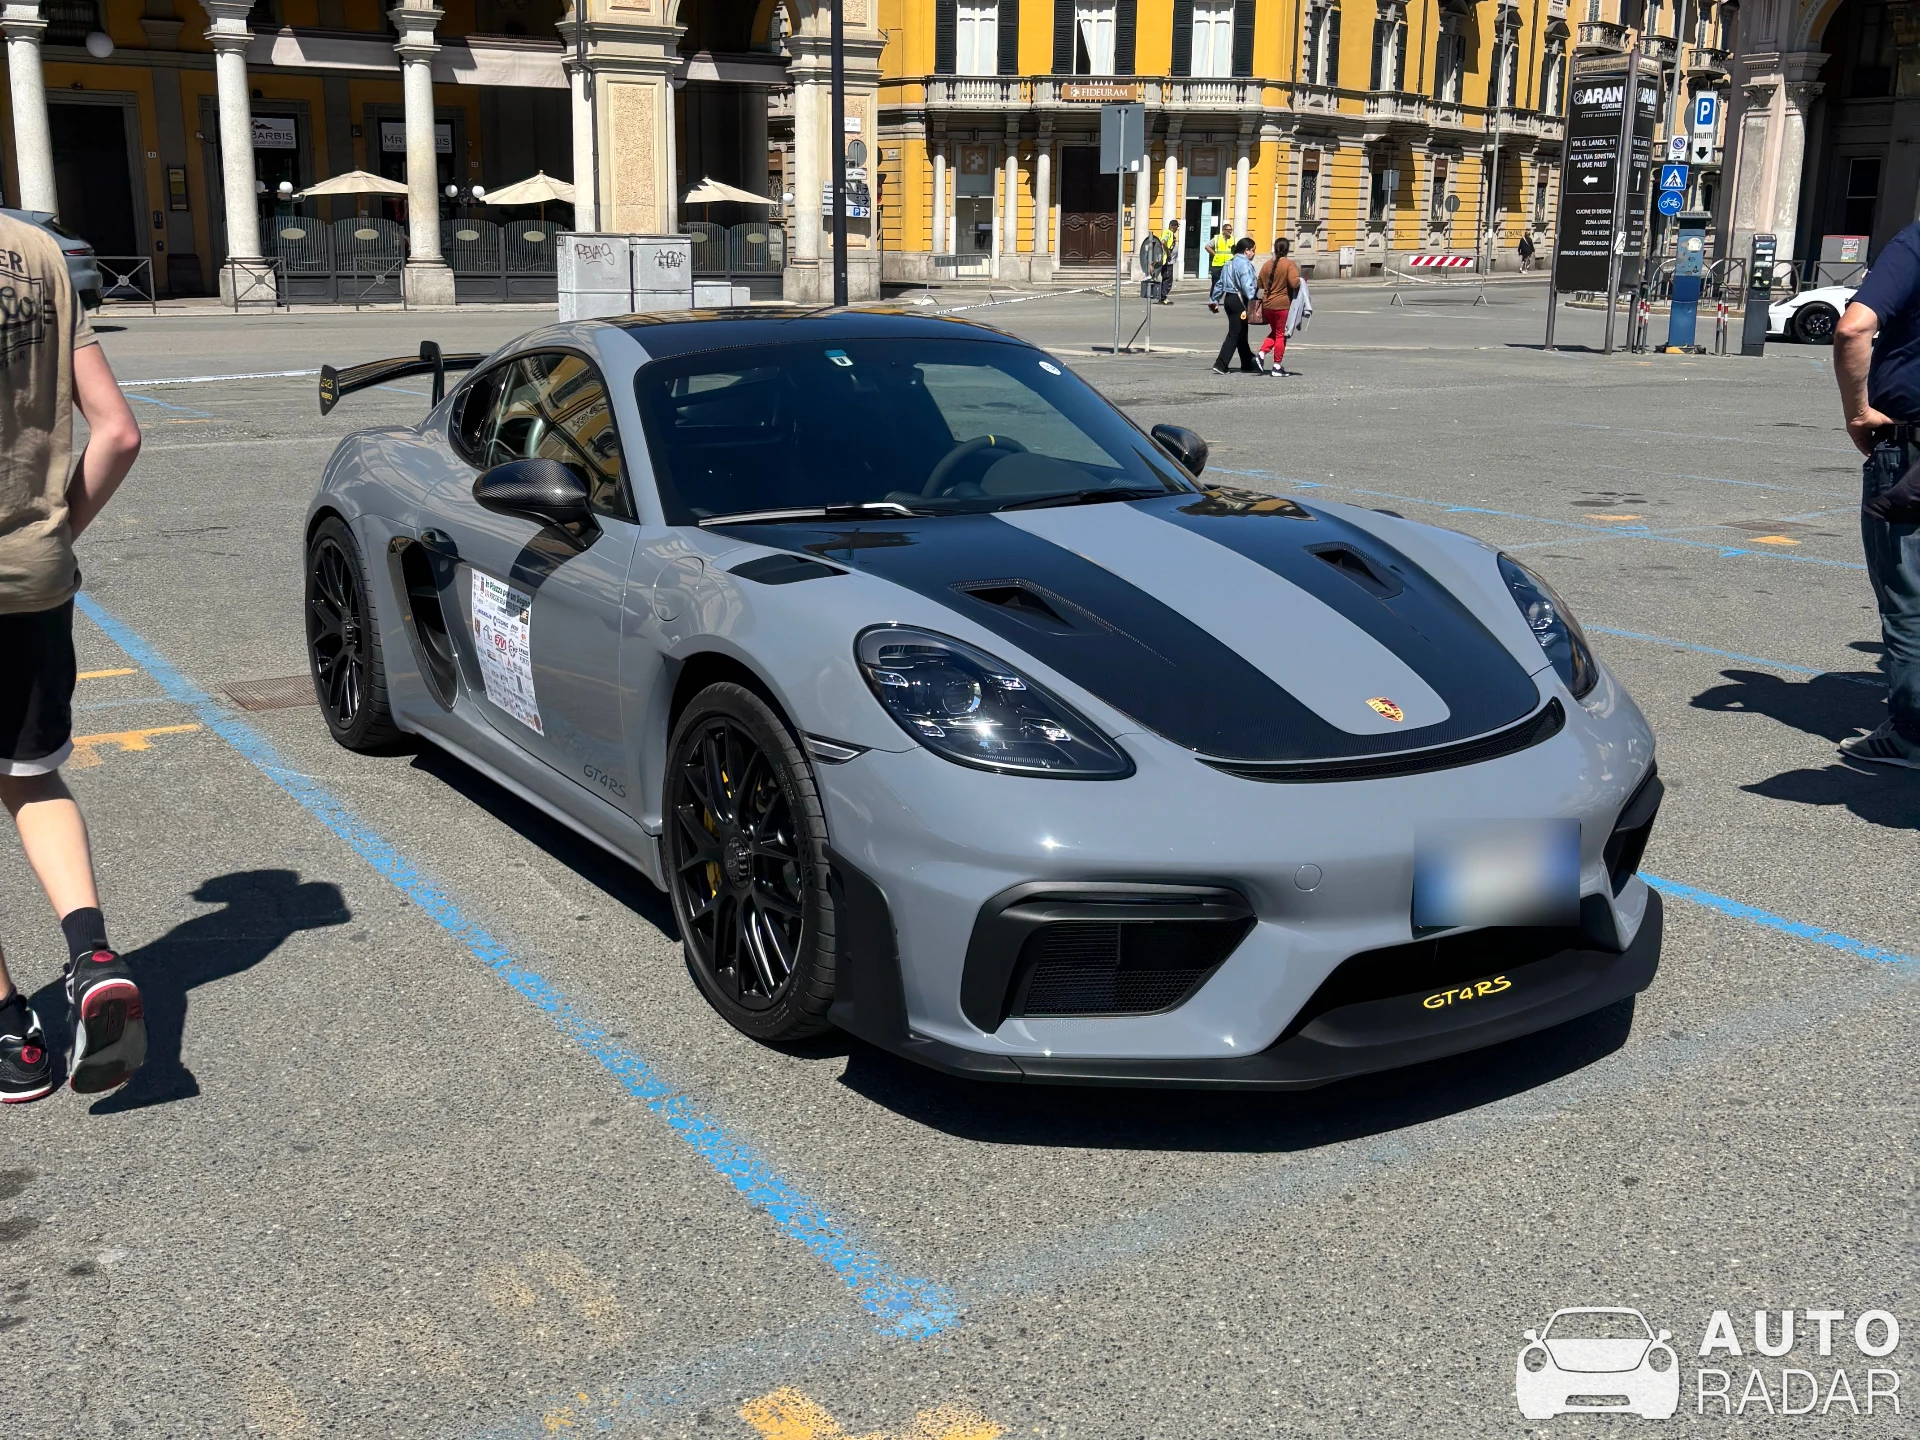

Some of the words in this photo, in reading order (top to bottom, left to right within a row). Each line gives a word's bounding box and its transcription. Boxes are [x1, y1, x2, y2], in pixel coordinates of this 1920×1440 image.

[1082, 88, 1128, 97] FIDEURAM
[1584, 86, 1624, 104] ARAN
[1700, 101, 1710, 121] P
[1589, 139, 1607, 147] LANZA,
[1594, 152, 1616, 160] SINISTRA
